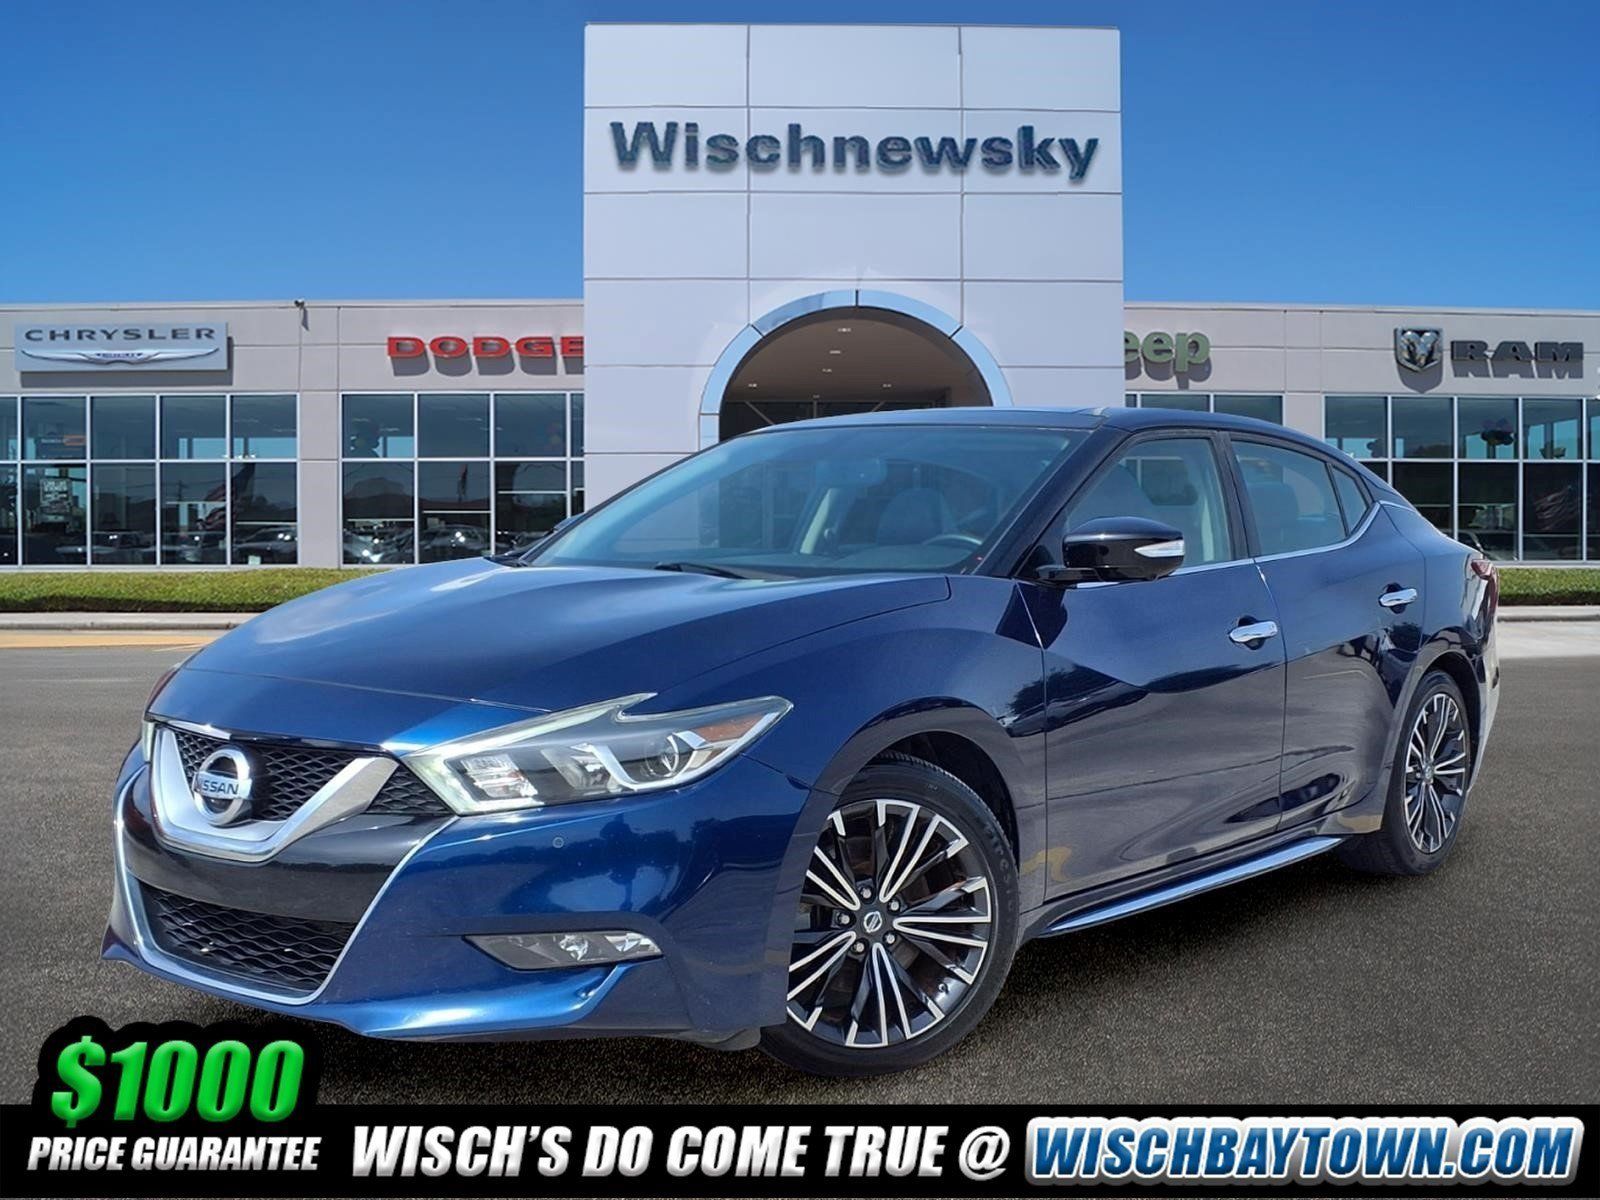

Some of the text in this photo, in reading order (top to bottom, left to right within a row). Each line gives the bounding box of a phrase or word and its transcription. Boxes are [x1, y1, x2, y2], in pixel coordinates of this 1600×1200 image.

[609, 121, 1099, 181] Wischnewsky
[24, 328, 216, 342] CHRYSLER
[387, 336, 584, 357] DODGE
[1124, 331, 1210, 372] ep
[1450, 340, 1584, 361] RAM
[196, 778, 239, 796] SSAN
